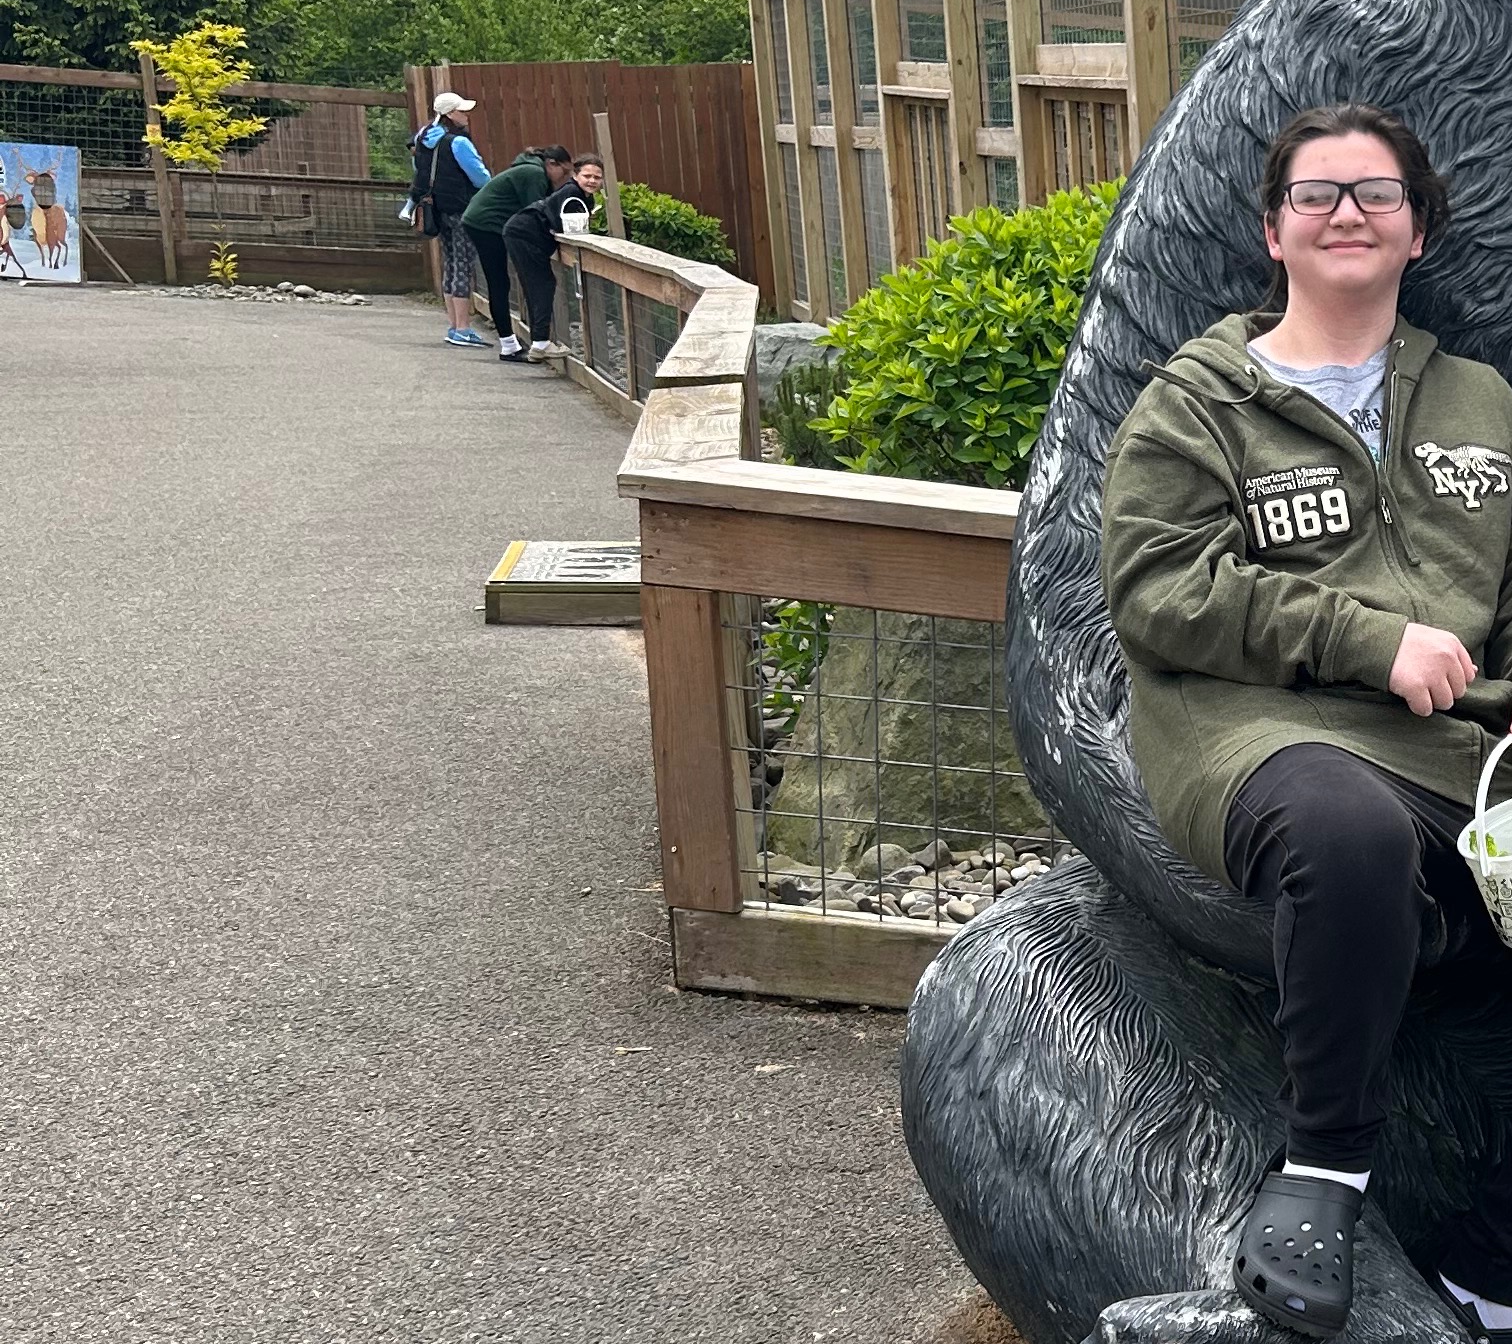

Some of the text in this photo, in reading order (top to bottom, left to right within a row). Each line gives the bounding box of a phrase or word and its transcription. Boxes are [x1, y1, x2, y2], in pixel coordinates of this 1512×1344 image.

[1244, 467, 1340, 489] American Museum
[1246, 476, 1335, 500] of Natural History
[1428, 467, 1480, 508] NY
[1246, 488, 1351, 549] 1869
